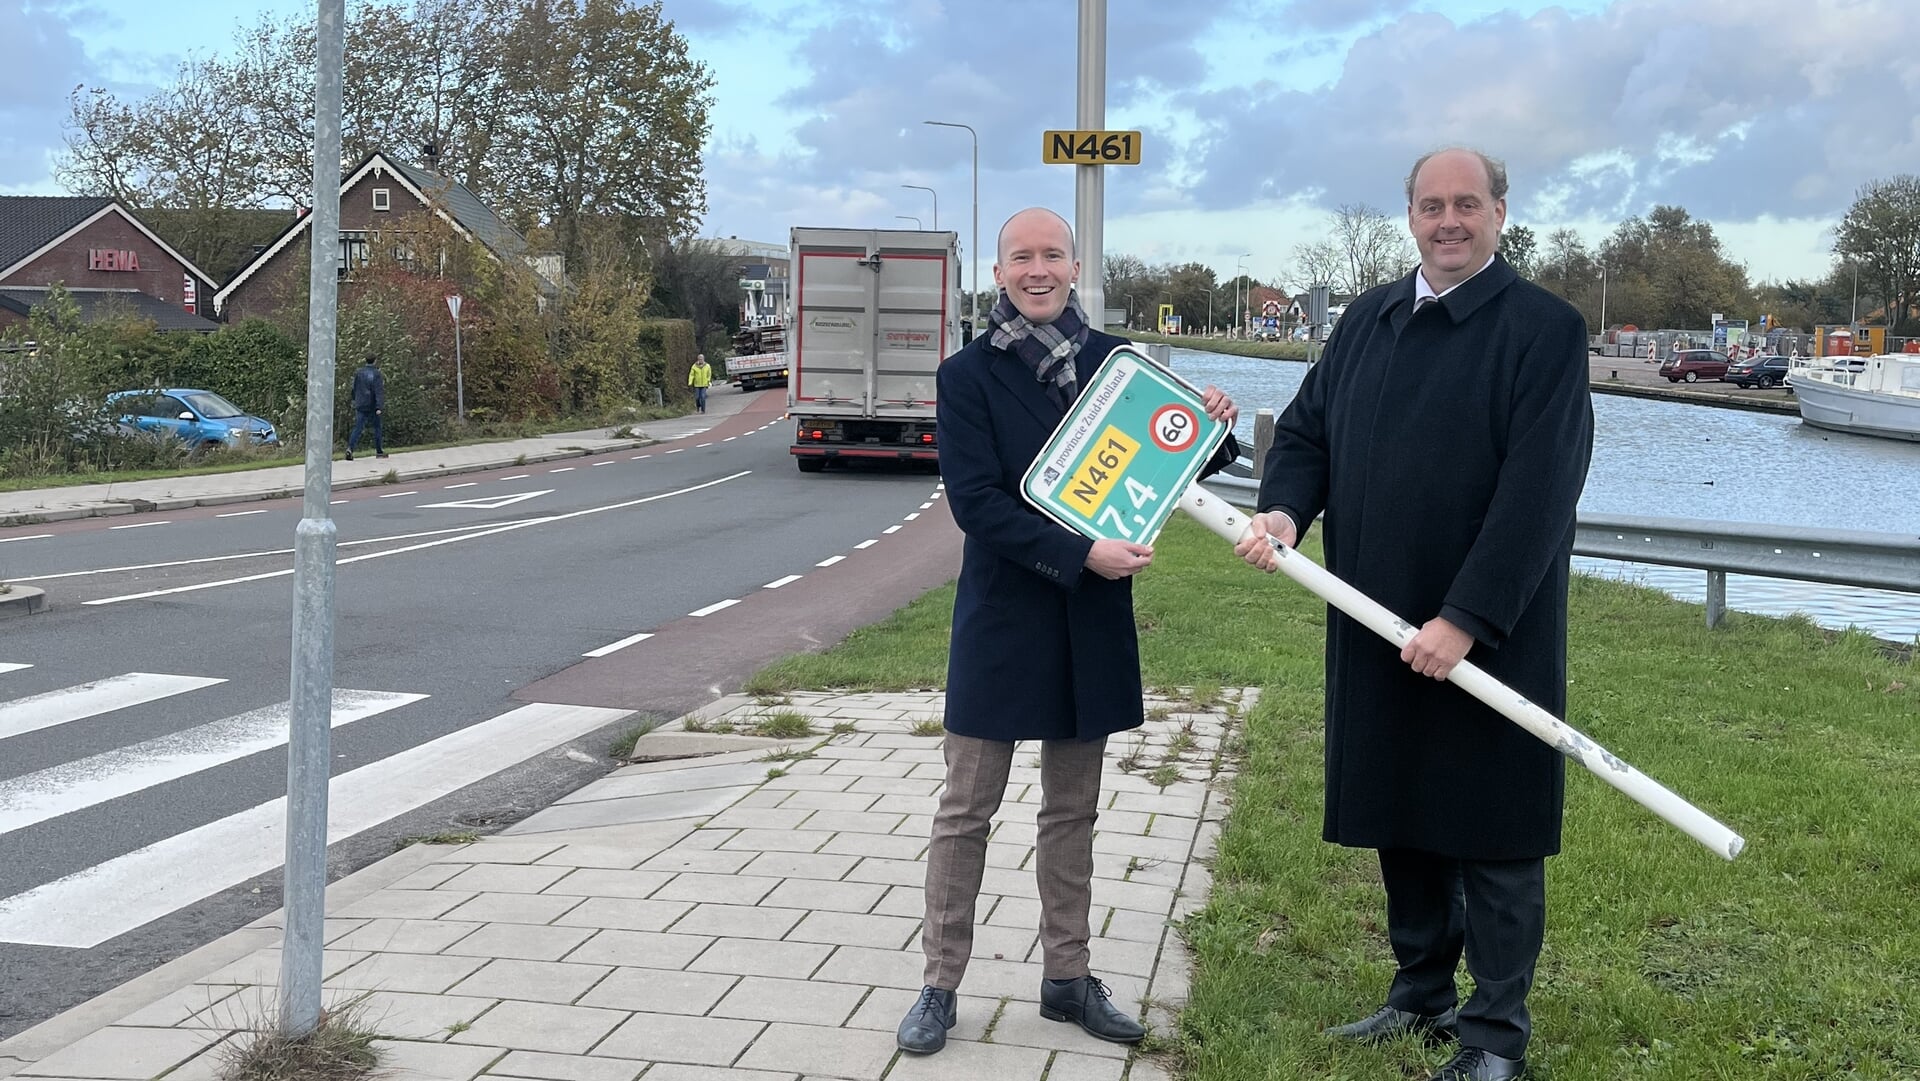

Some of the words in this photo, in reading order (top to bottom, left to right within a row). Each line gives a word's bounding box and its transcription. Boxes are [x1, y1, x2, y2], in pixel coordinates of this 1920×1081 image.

[1053, 134, 1131, 160] N461
[90, 248, 140, 271] HEMA
[1056, 424, 1087, 468] provincie
[1082, 369, 1126, 426] Zuid-Holland
[1163, 413, 1188, 443] 60
[1073, 438, 1128, 504] N461
[1097, 477, 1158, 538] 7,4
